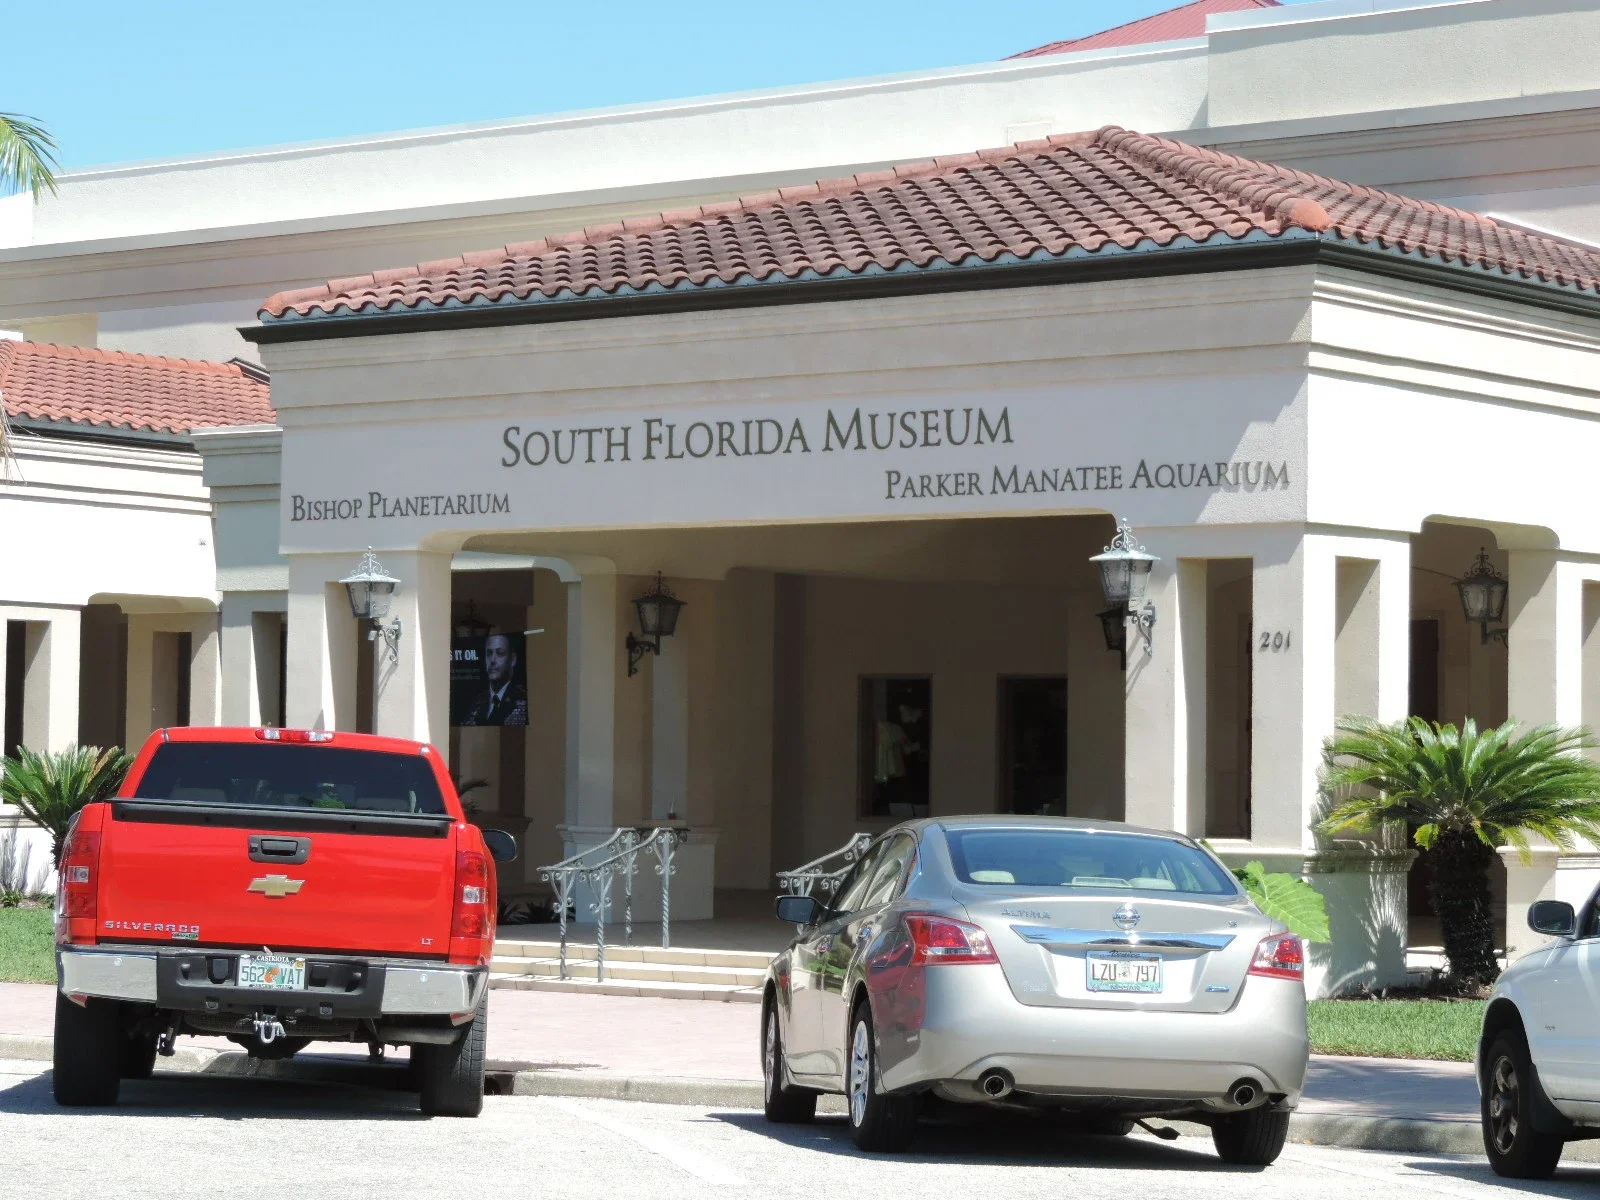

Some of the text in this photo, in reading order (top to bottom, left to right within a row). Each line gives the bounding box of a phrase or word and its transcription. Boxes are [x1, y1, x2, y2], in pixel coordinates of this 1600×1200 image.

[502, 406, 1014, 467] SOUTH FLORIDA MUSEUM
[884, 458, 1291, 500] PARKER MANATEE AQUARIUM
[291, 491, 511, 522] BISHOP PLANETARIUM
[1259, 630, 1291, 650] 201
[105, 920, 200, 934] SILVERADO
[241, 966, 303, 985] 562 VAT
[1092, 963, 1157, 982] LZU 797
